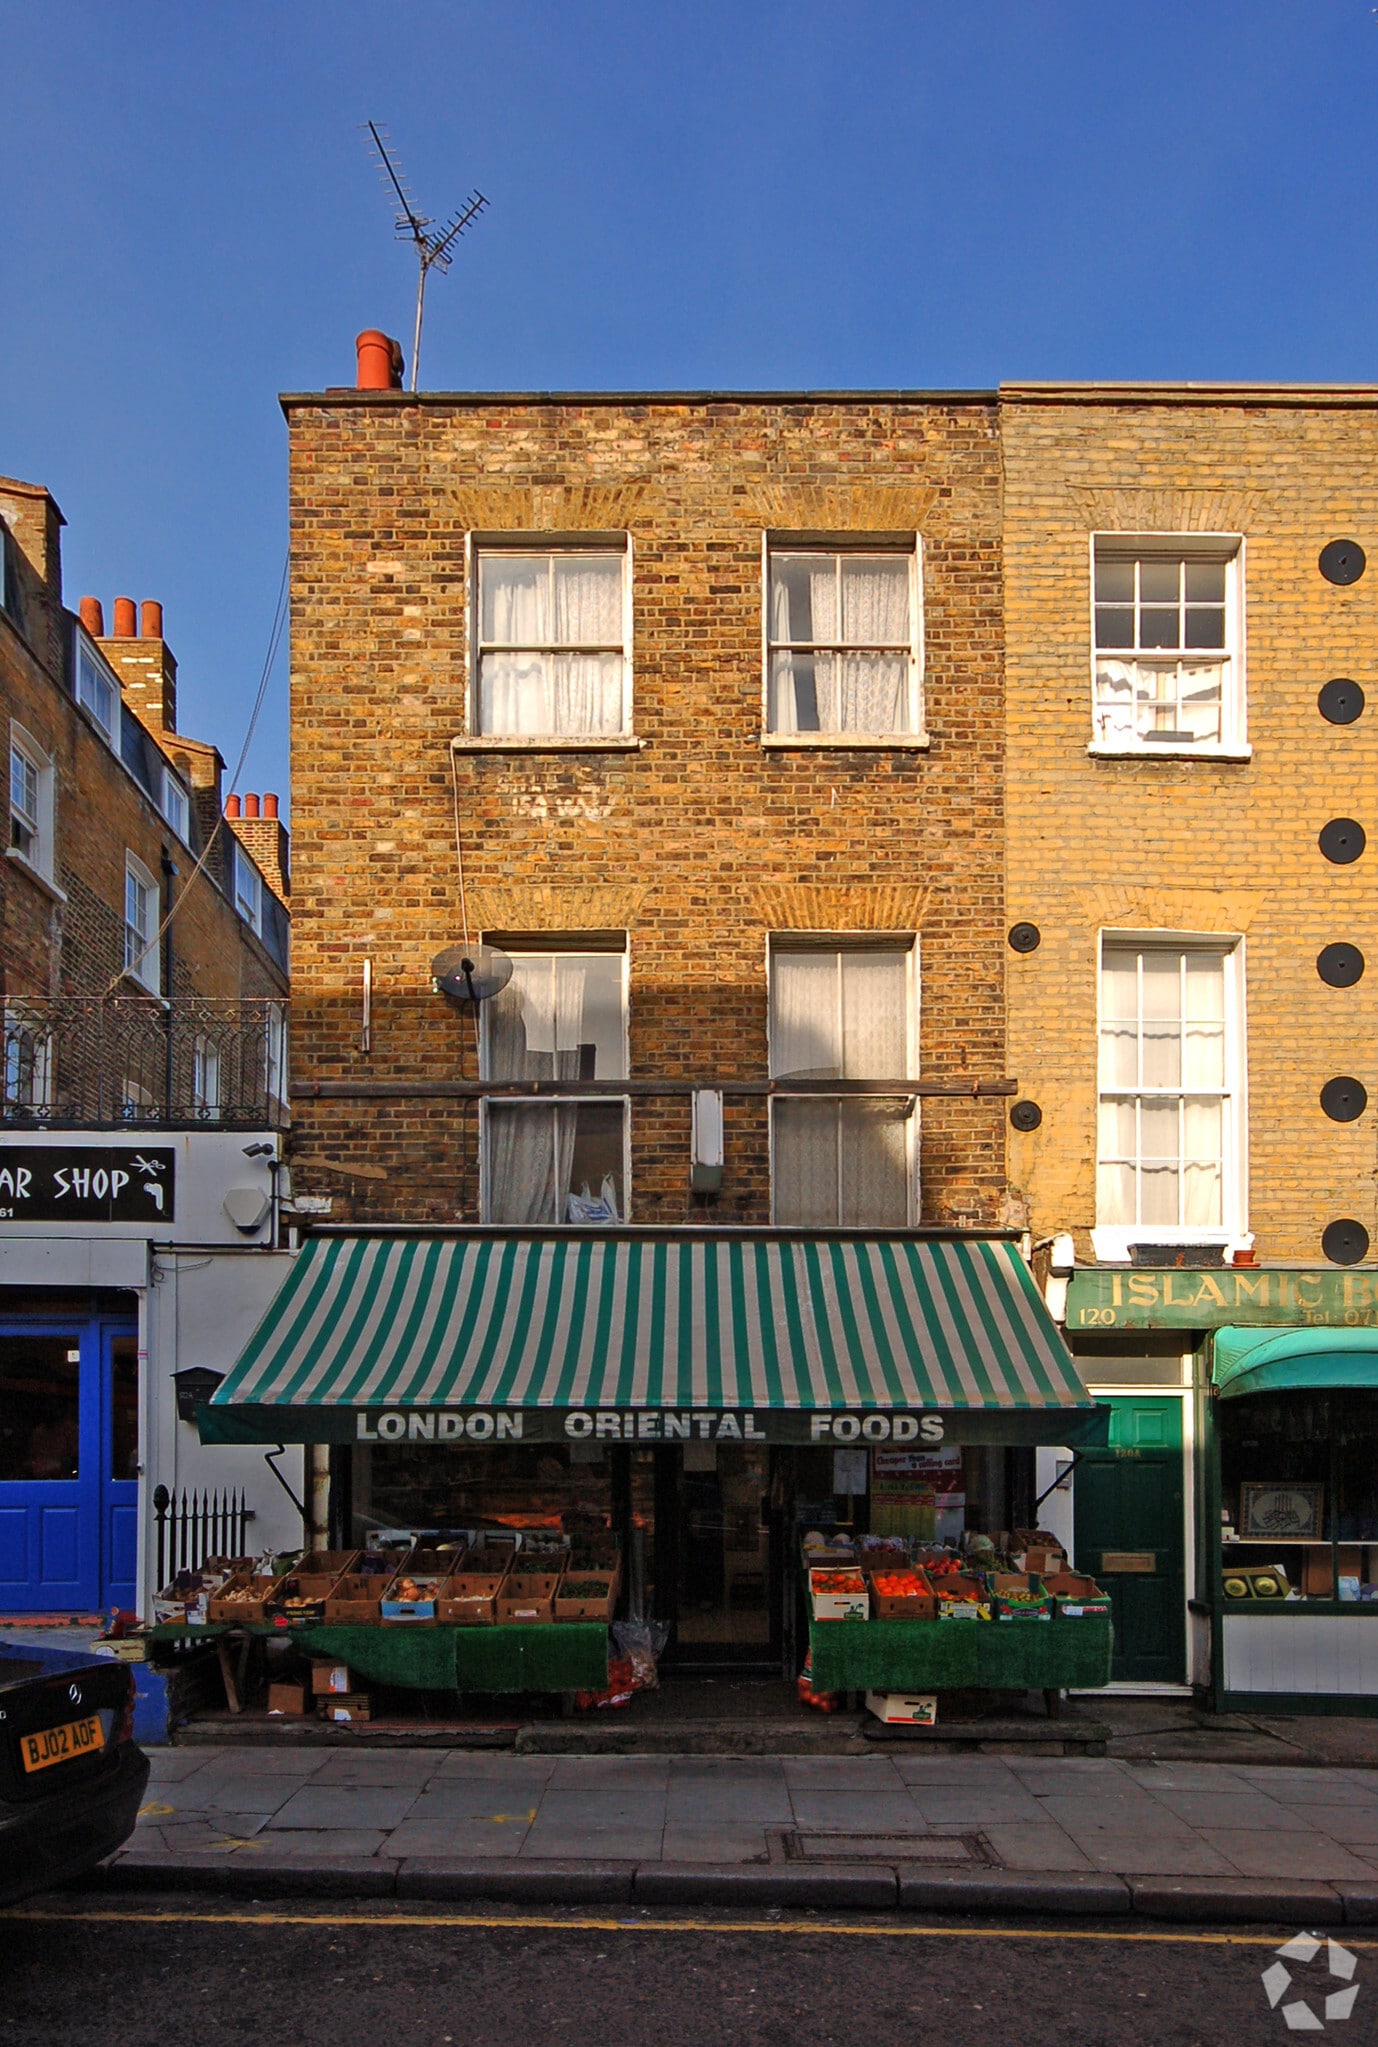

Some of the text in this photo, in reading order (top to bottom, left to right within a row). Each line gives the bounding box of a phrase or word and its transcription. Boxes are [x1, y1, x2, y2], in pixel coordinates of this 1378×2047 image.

[53, 1168, 129, 1199] SHOP
[1112, 1274, 1378, 1307] ISLAMIC B
[1079, 1308, 1116, 1325] 120
[356, 1411, 944, 1442] LONDON ORIENTAL FOODS
[877, 1455, 906, 1465] Cheaper
[27, 1729, 70, 1765] BJ02
